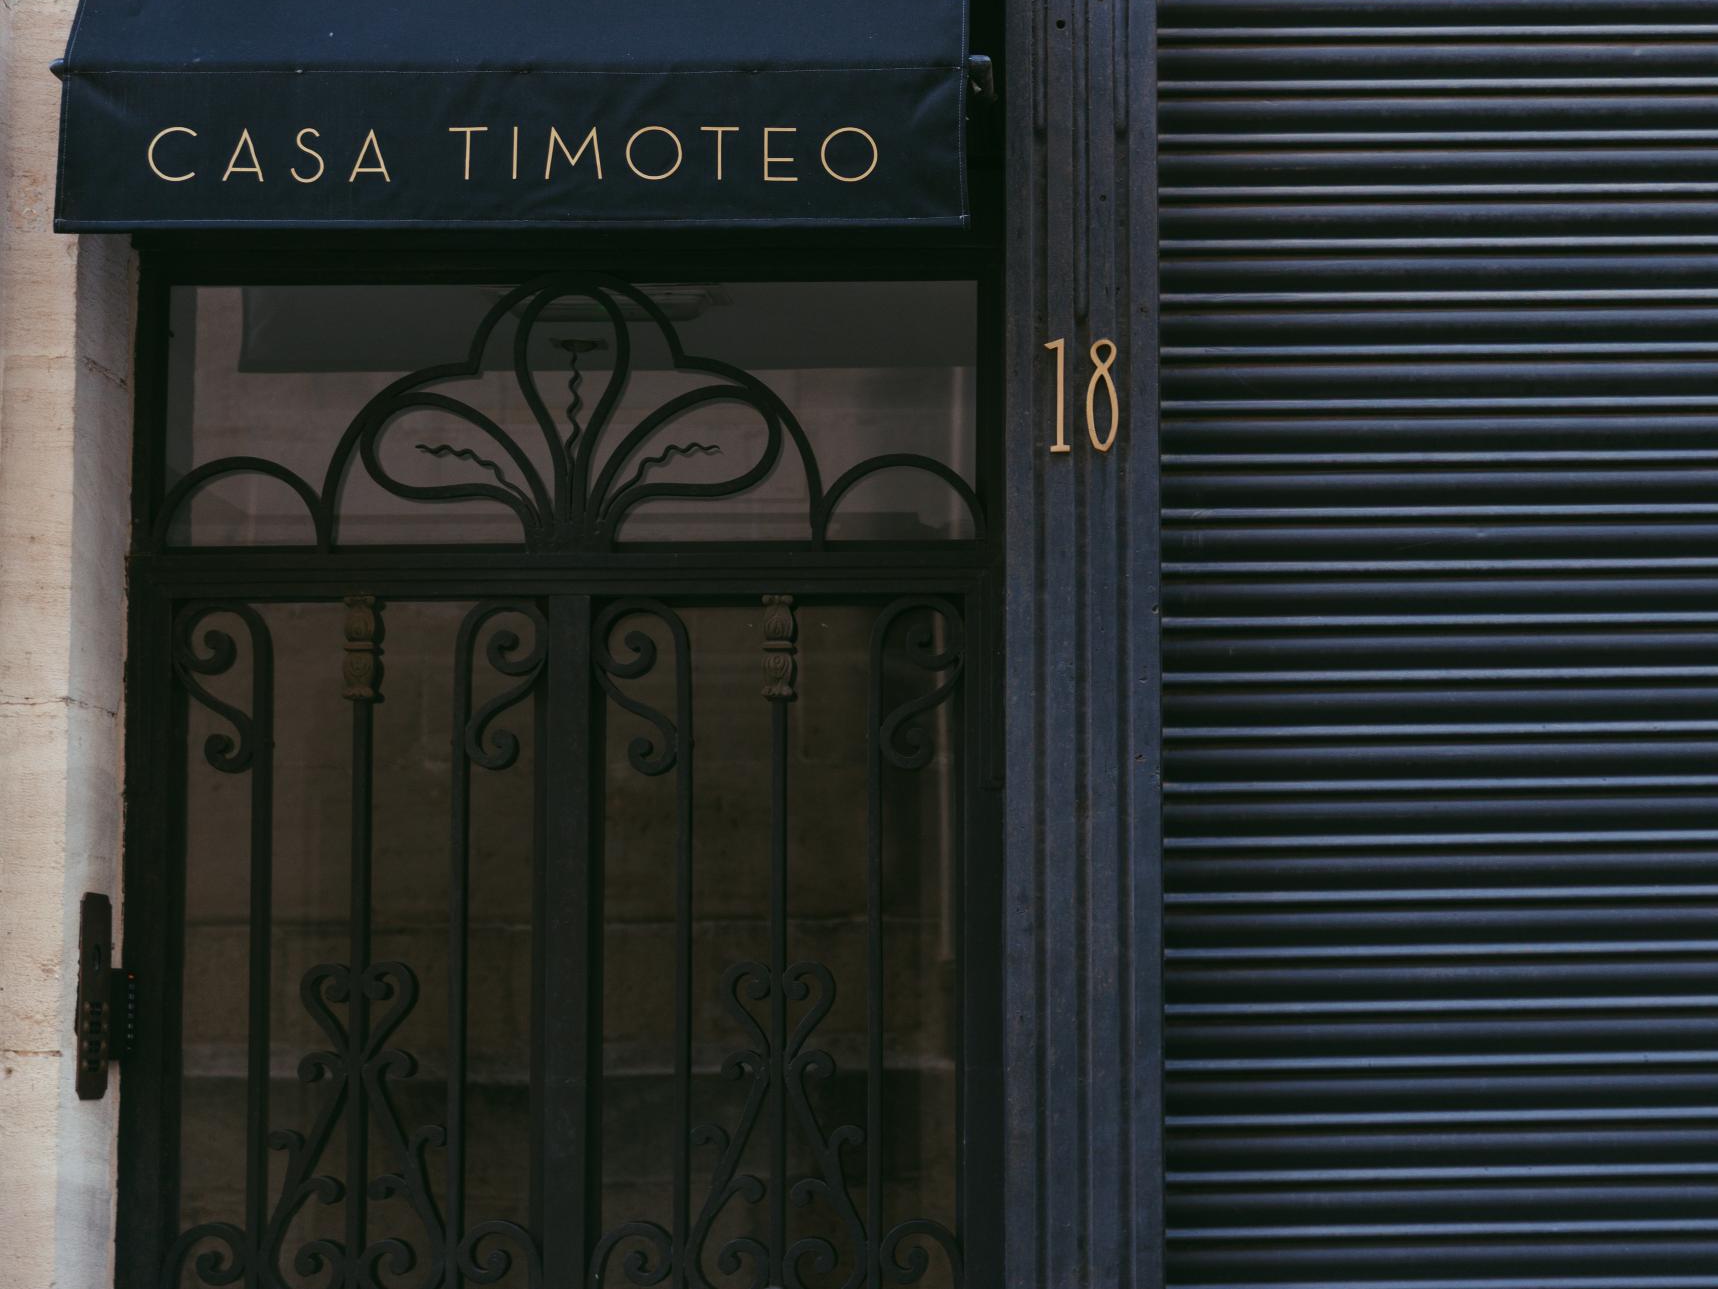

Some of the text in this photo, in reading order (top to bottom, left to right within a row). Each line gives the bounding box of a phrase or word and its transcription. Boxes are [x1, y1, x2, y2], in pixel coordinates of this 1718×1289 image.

[147, 125, 878, 184] CASA TIMOTEO
[1043, 337, 1119, 453] 18
